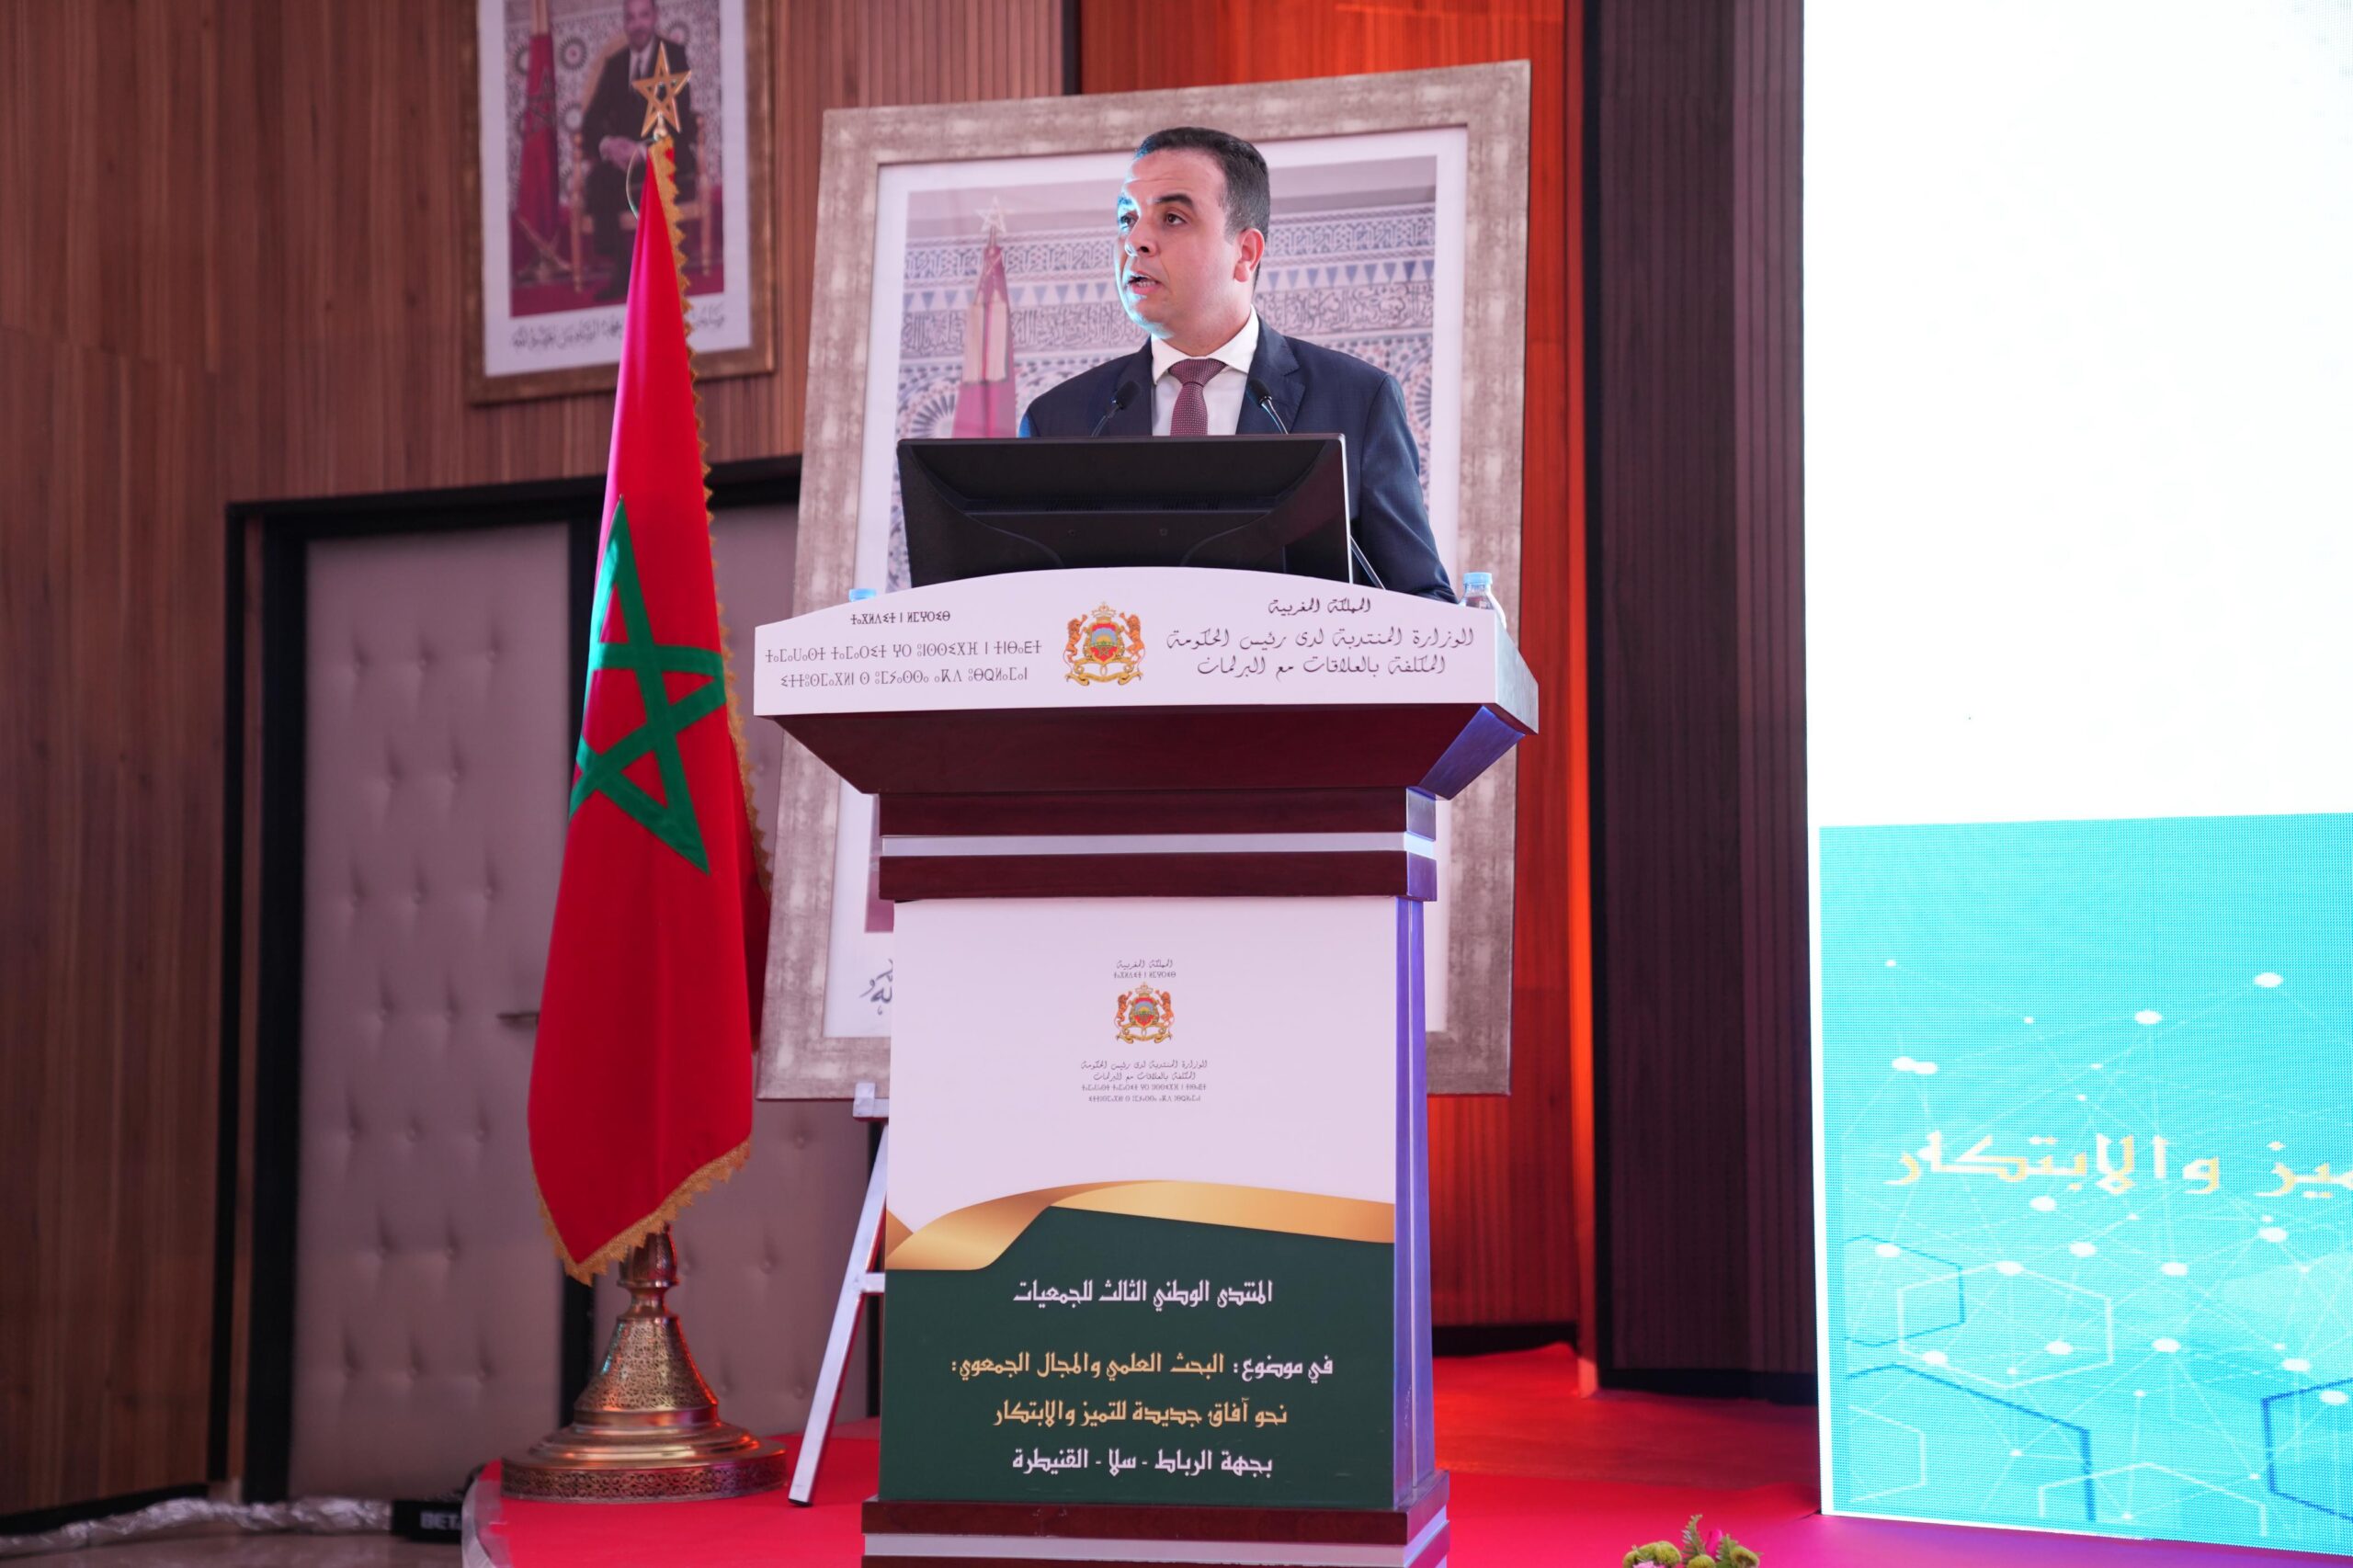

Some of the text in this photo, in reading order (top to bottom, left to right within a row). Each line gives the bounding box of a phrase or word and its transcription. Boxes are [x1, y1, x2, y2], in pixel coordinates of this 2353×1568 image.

[1267, 597, 1370, 616] المملكة المغربية
[1166, 626, 1474, 650] الوزارة المنتدبة لدى رئيس الحكومة
[1197, 653, 1446, 682] المكلفة بالعلاقات مع البرلمان
[1883, 1130, 2220, 1195] والابتكار
[1013, 1279, 1273, 1312] المنتدى الوطني الثالث للجمعيات
[1037, 1351, 1101, 1379] والمجال
[1106, 1352, 1162, 1381] العلمي
[1170, 1352, 1224, 1381] البحث
[1308, 1355, 1334, 1384] في
[993, 1397, 1288, 1427] نحو آفاق جديدة للتميز والابتكار
[1012, 1447, 1089, 1475] القنيطرة
[1108, 1448, 1137, 1477] سلا
[1154, 1449, 1213, 1476] الرباط
[1221, 1449, 1273, 1478] بجهة
